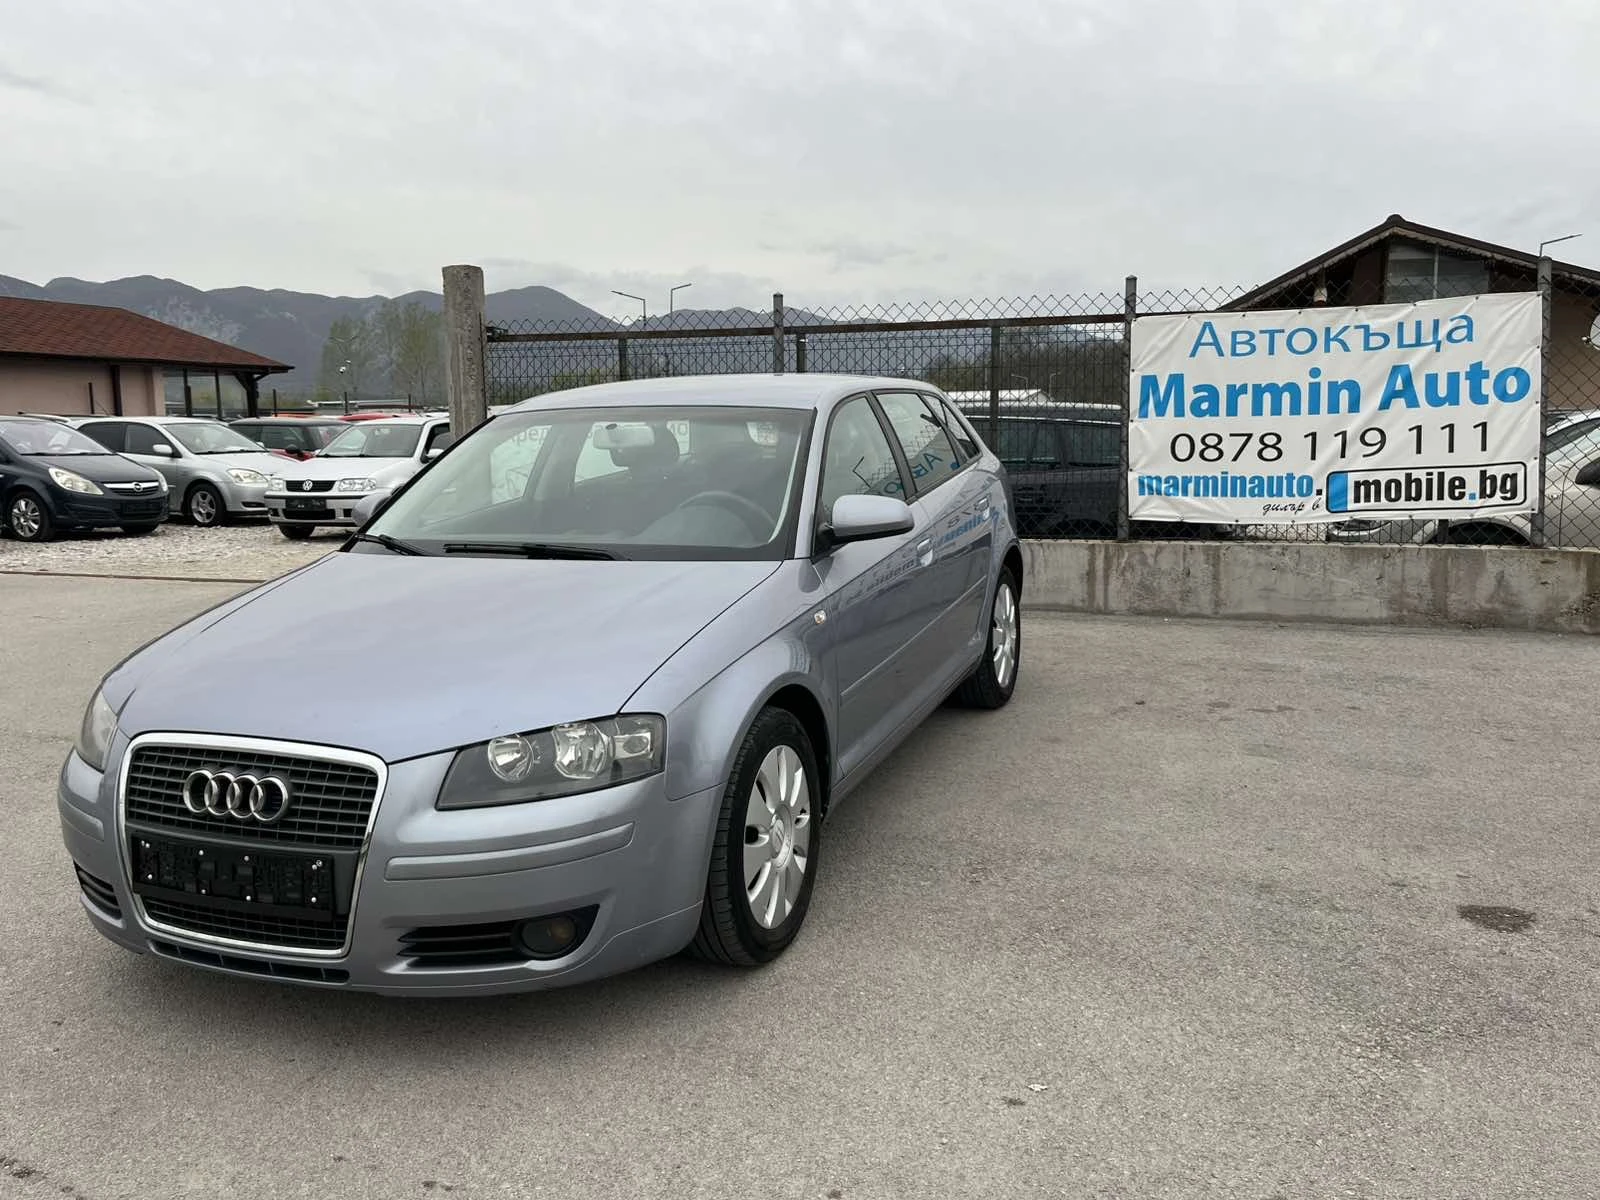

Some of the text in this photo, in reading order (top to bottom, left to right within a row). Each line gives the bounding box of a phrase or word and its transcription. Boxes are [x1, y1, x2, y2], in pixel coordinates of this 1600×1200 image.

[1189, 314, 1474, 358] Автокъща
[1138, 361, 1531, 419] Marmin Auto
[1170, 421, 1487, 462] 0878 119 111
[1353, 469, 1518, 503] mobile.bg
